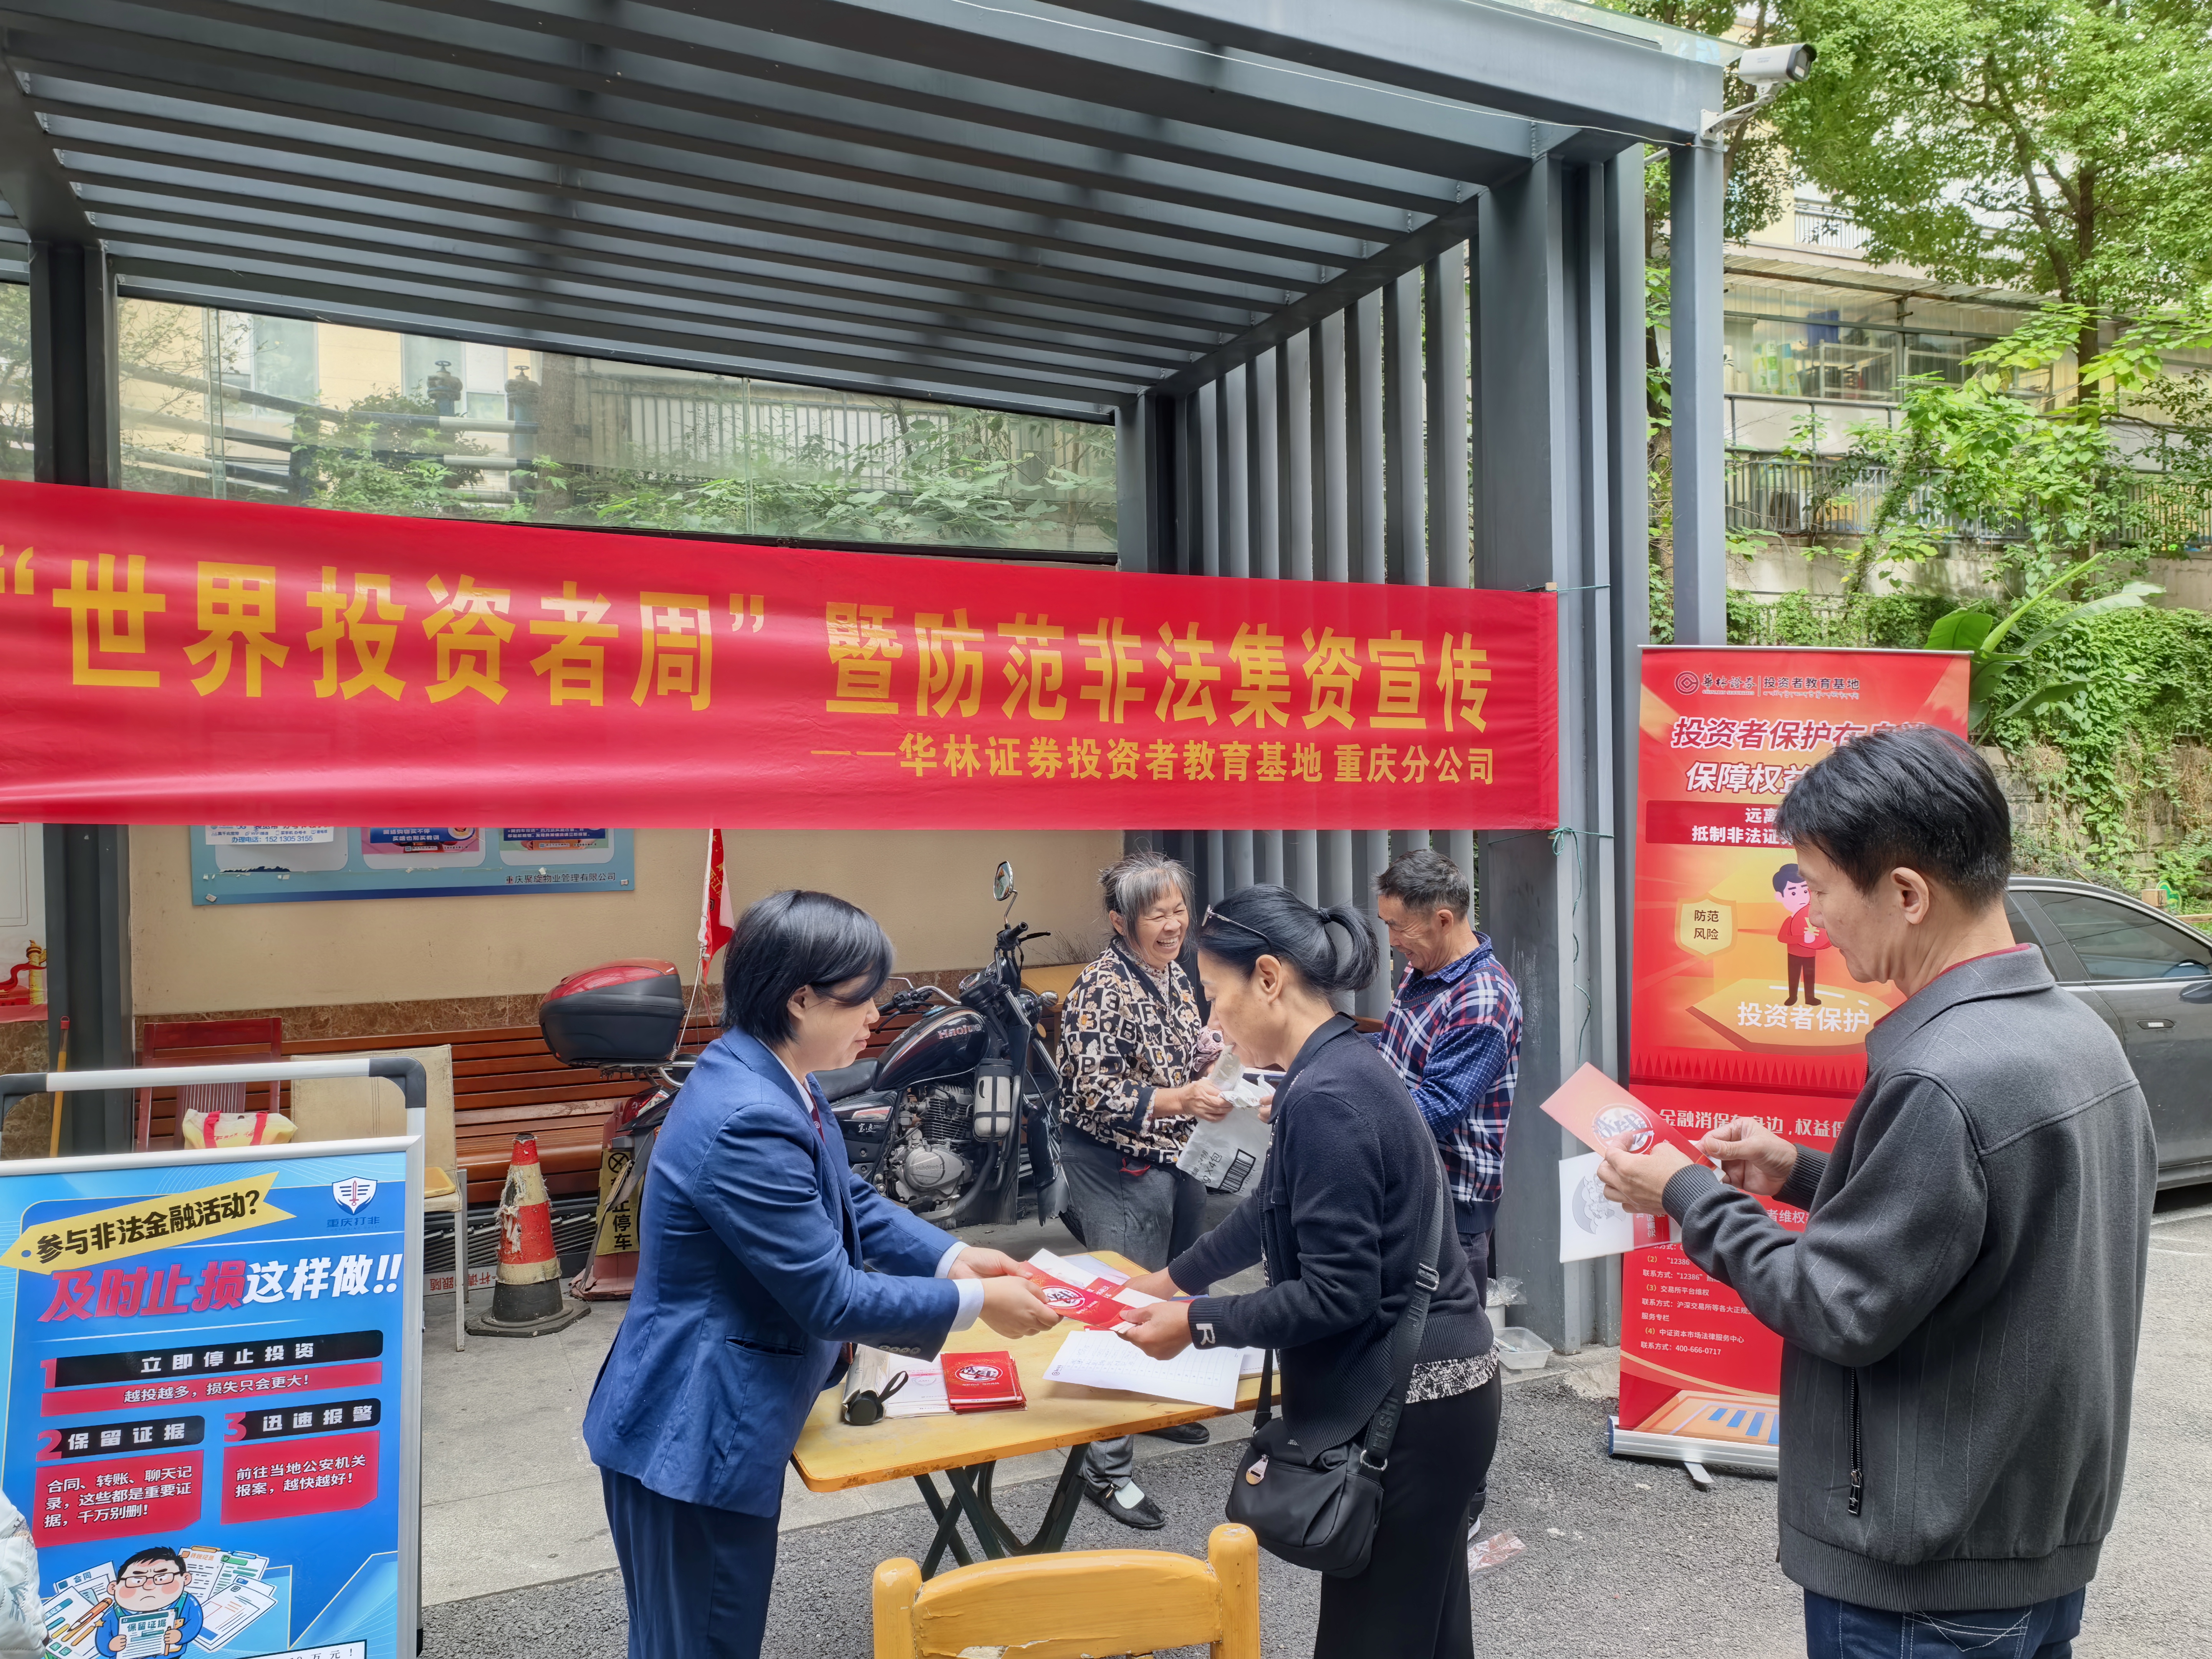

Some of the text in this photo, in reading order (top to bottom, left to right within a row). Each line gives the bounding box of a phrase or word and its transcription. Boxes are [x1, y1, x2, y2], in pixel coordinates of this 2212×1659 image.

[825, 601, 1492, 732] 暨防范非法集资宣传
[1764, 676, 1860, 690] 投资者教育基地
[1671, 717, 1927, 752] 投资者保护在
[1334, 743, 1495, 785] 重庆分公司
[1694, 910, 1719, 922] 防范
[1694, 928, 1719, 940] 风险
[1738, 1001, 1870, 1033] 投资者保护
[36, 1190, 260, 1264] 参与非法金融活动?
[326, 1216, 380, 1228] 重庆打非
[611, 1177, 633, 1250] 止停车
[1767, 1209, 1809, 1224] 者维权
[1660, 1285, 1710, 1296] 交易所平台维权
[1641, 1313, 1670, 1322] 服务专栏
[1659, 1328, 1745, 1343] 中证资本市场法律服务中心
[40, 1342, 315, 1388] 1 立即停止投资
[223, 1405, 373, 1442] 3 迅速报警
[36, 1422, 185, 1460] 2 保留证据
[47, 1465, 192, 1493] 合同、转账、聊天记
[236, 1454, 366, 1481] 前往当地公安机关
[73, 1571, 92, 1583] 合同
[127, 1619, 167, 1632] 保留证据
